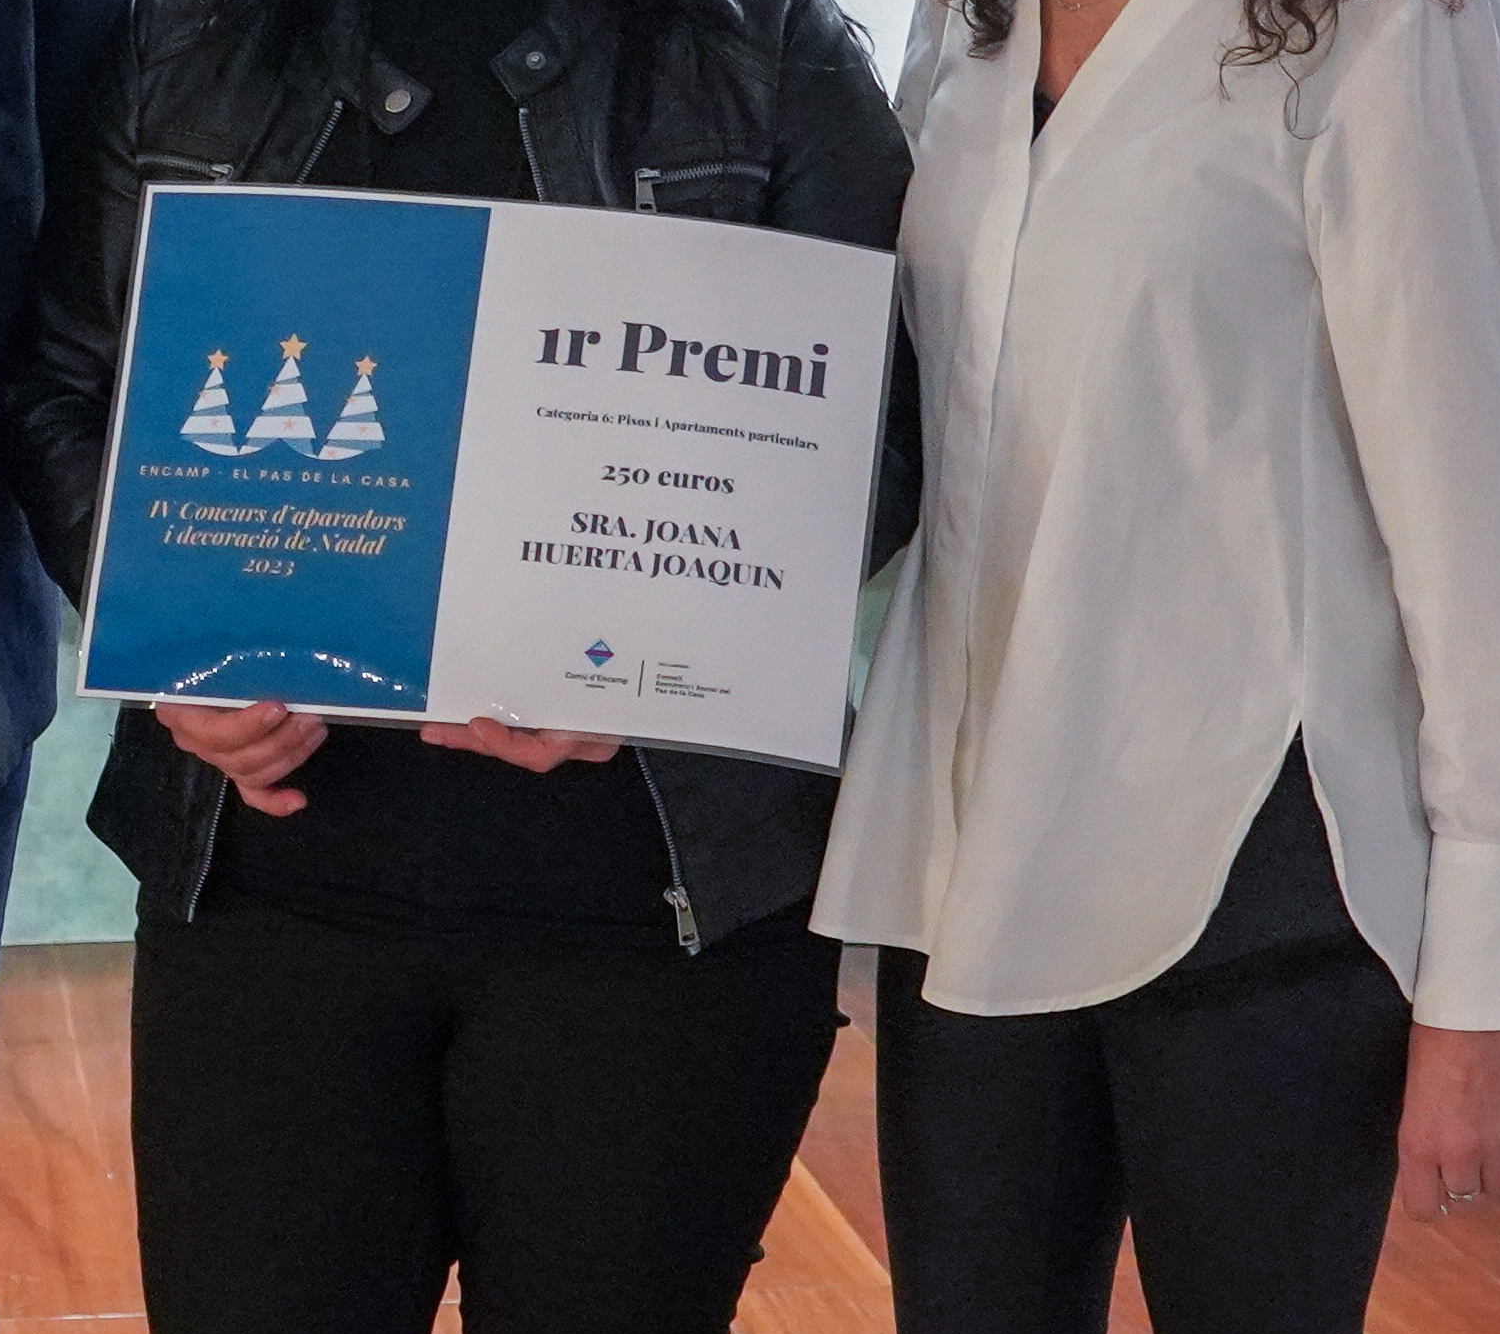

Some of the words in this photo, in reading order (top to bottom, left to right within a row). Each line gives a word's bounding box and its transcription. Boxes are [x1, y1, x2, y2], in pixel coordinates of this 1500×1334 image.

[534, 327, 601, 369] 1r
[615, 321, 829, 399] Premi
[616, 413, 651, 428] Pisos
[661, 417, 746, 439] Apartaments
[747, 430, 819, 452] particulars
[139, 465, 210, 478] ENCAMP
[232, 468, 250, 480] EL
[259, 469, 292, 482] PAS
[301, 471, 321, 483] DE
[330, 472, 351, 485] LA
[361, 475, 411, 488] CASA
[600, 465, 650, 487] 250
[657, 469, 735, 495] euros
[149, 500, 173, 519] IV
[179, 501, 267, 524] Concurs
[271, 504, 406, 531] d'aparadors
[570, 511, 637, 538] SRA.
[642, 518, 742, 551] JOANA
[176, 525, 280, 551] decoració
[284, 529, 309, 551] de
[312, 533, 387, 555] Nadal
[242, 559, 295, 577] 2023
[520, 540, 644, 573] HUERTA
[650, 552, 785, 590] JOAQUIN
